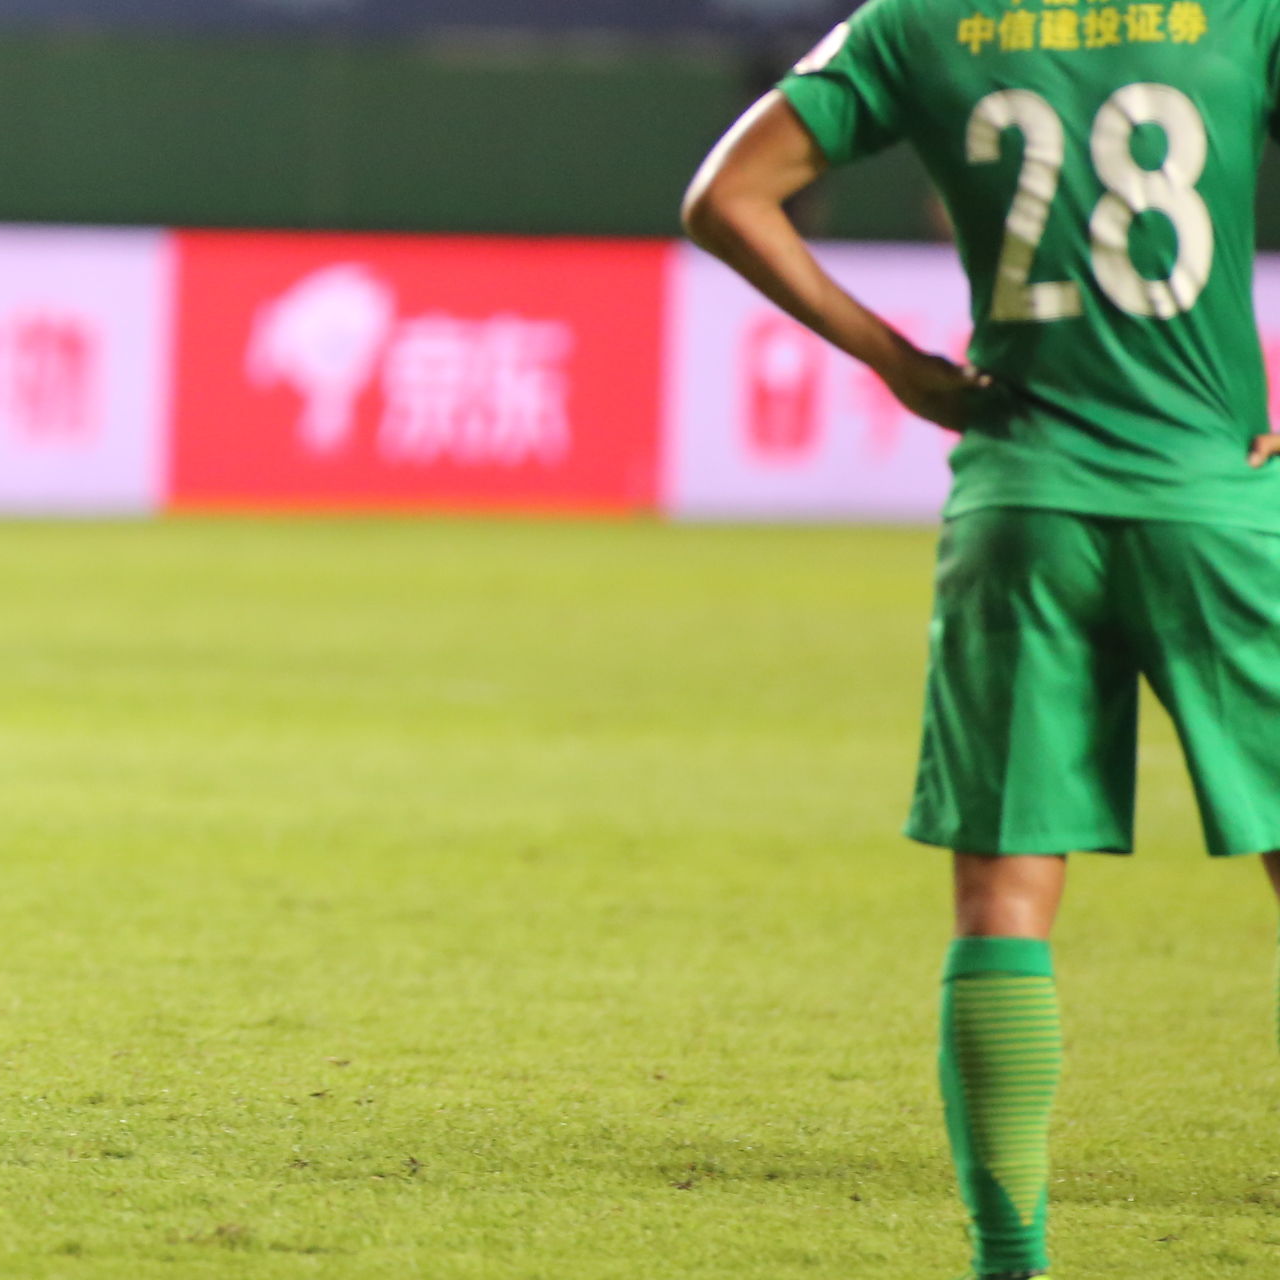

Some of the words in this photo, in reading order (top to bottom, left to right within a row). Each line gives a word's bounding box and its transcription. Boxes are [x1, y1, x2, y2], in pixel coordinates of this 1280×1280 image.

[957, 0, 1208, 55] 中信建投证券
[964, 82, 1215, 323] 28
